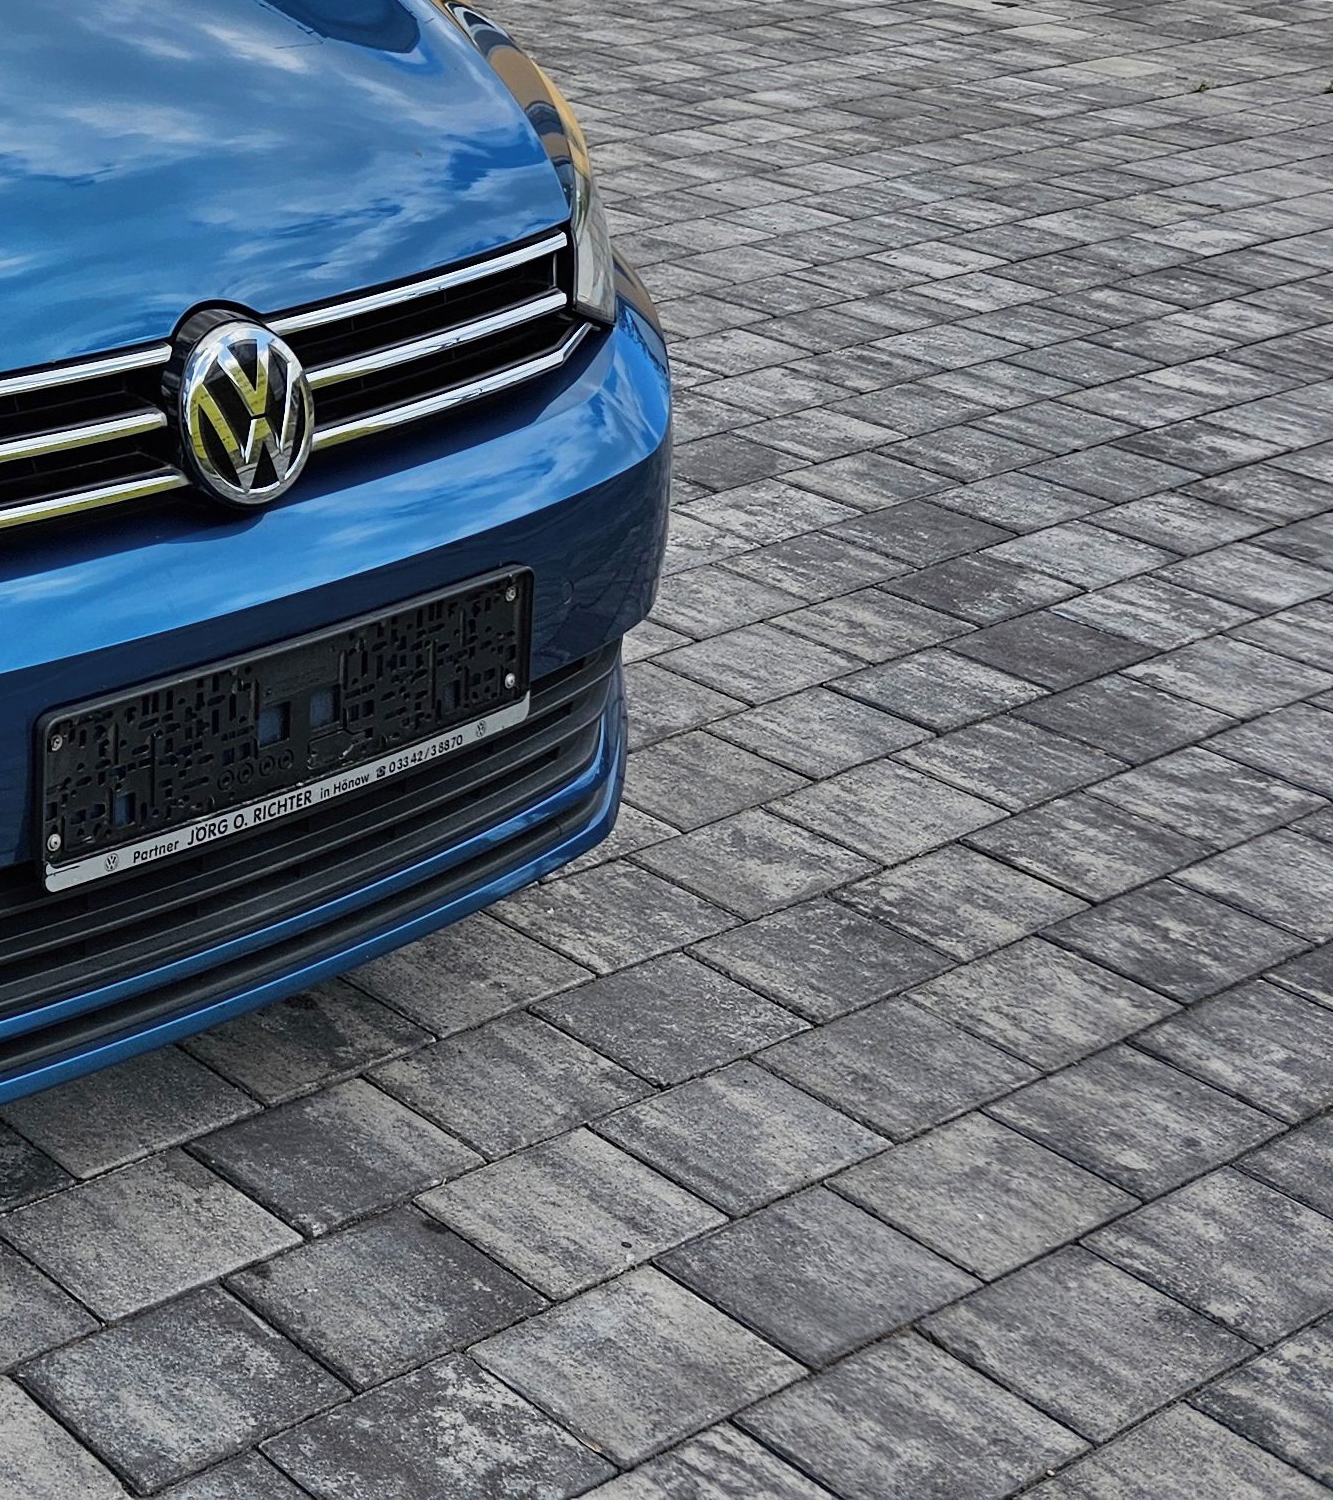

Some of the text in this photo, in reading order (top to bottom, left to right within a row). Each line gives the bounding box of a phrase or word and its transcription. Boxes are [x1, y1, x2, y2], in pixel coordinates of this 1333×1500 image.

[133, 841, 180, 864] Partner
[187, 820, 229, 846] JÖRG
[233, 813, 248, 830] O.
[253, 790, 313, 824] RICHTER
[320, 787, 330, 800] in
[333, 774, 370, 795] Hönow
